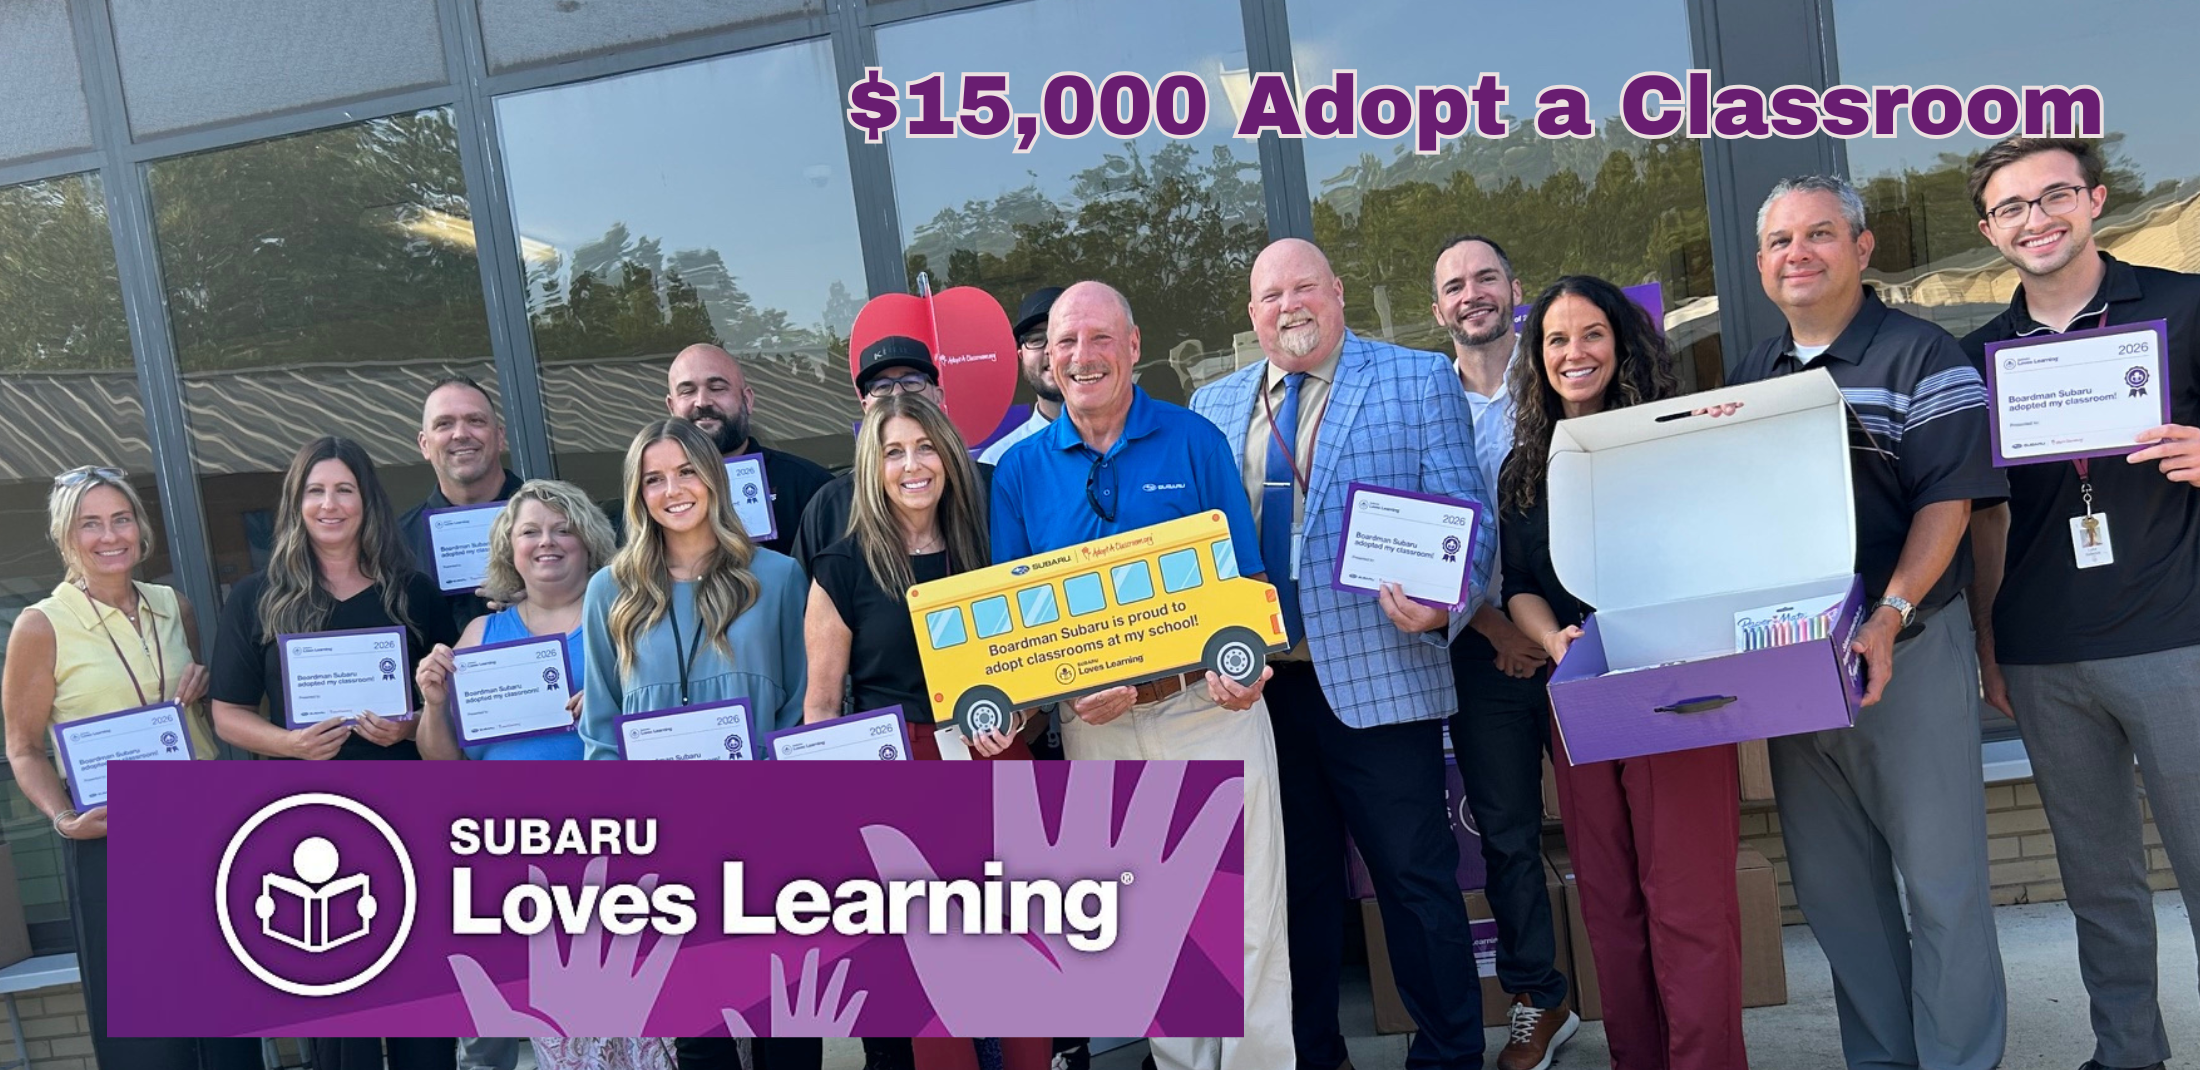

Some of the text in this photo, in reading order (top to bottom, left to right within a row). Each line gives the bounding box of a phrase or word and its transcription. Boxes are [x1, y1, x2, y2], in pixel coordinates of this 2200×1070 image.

[2118, 342, 2149, 355] 2026
[2008, 387, 2092, 403] Boardman Subaru
[2009, 392, 2117, 412] adopted my classroom!
[736, 467, 755, 477] 2026
[1442, 514, 1466, 526] 2026
[1356, 532, 1418, 549] Boardman Subaru
[1354, 540, 1435, 559] adopted my classroom!
[1032, 555, 1071, 570] SUBARU
[988, 601, 1187, 657] Boardman Subaru is proud to
[373, 640, 395, 650] 2026
[985, 614, 1199, 676] adopt classrooms at my school!
[536, 649, 558, 659] 2026
[1078, 654, 1144, 675] Loves Learning
[297, 673, 332, 682] Boardman
[297, 680, 326, 688] adopted
[464, 683, 522, 698] Boardman Subaru
[465, 695, 492, 704] adopted
[151, 714, 174, 726] 2026
[716, 714, 741, 727] 2026
[869, 723, 894, 737] 2026
[79, 749, 141, 766] Boardman Subaru
